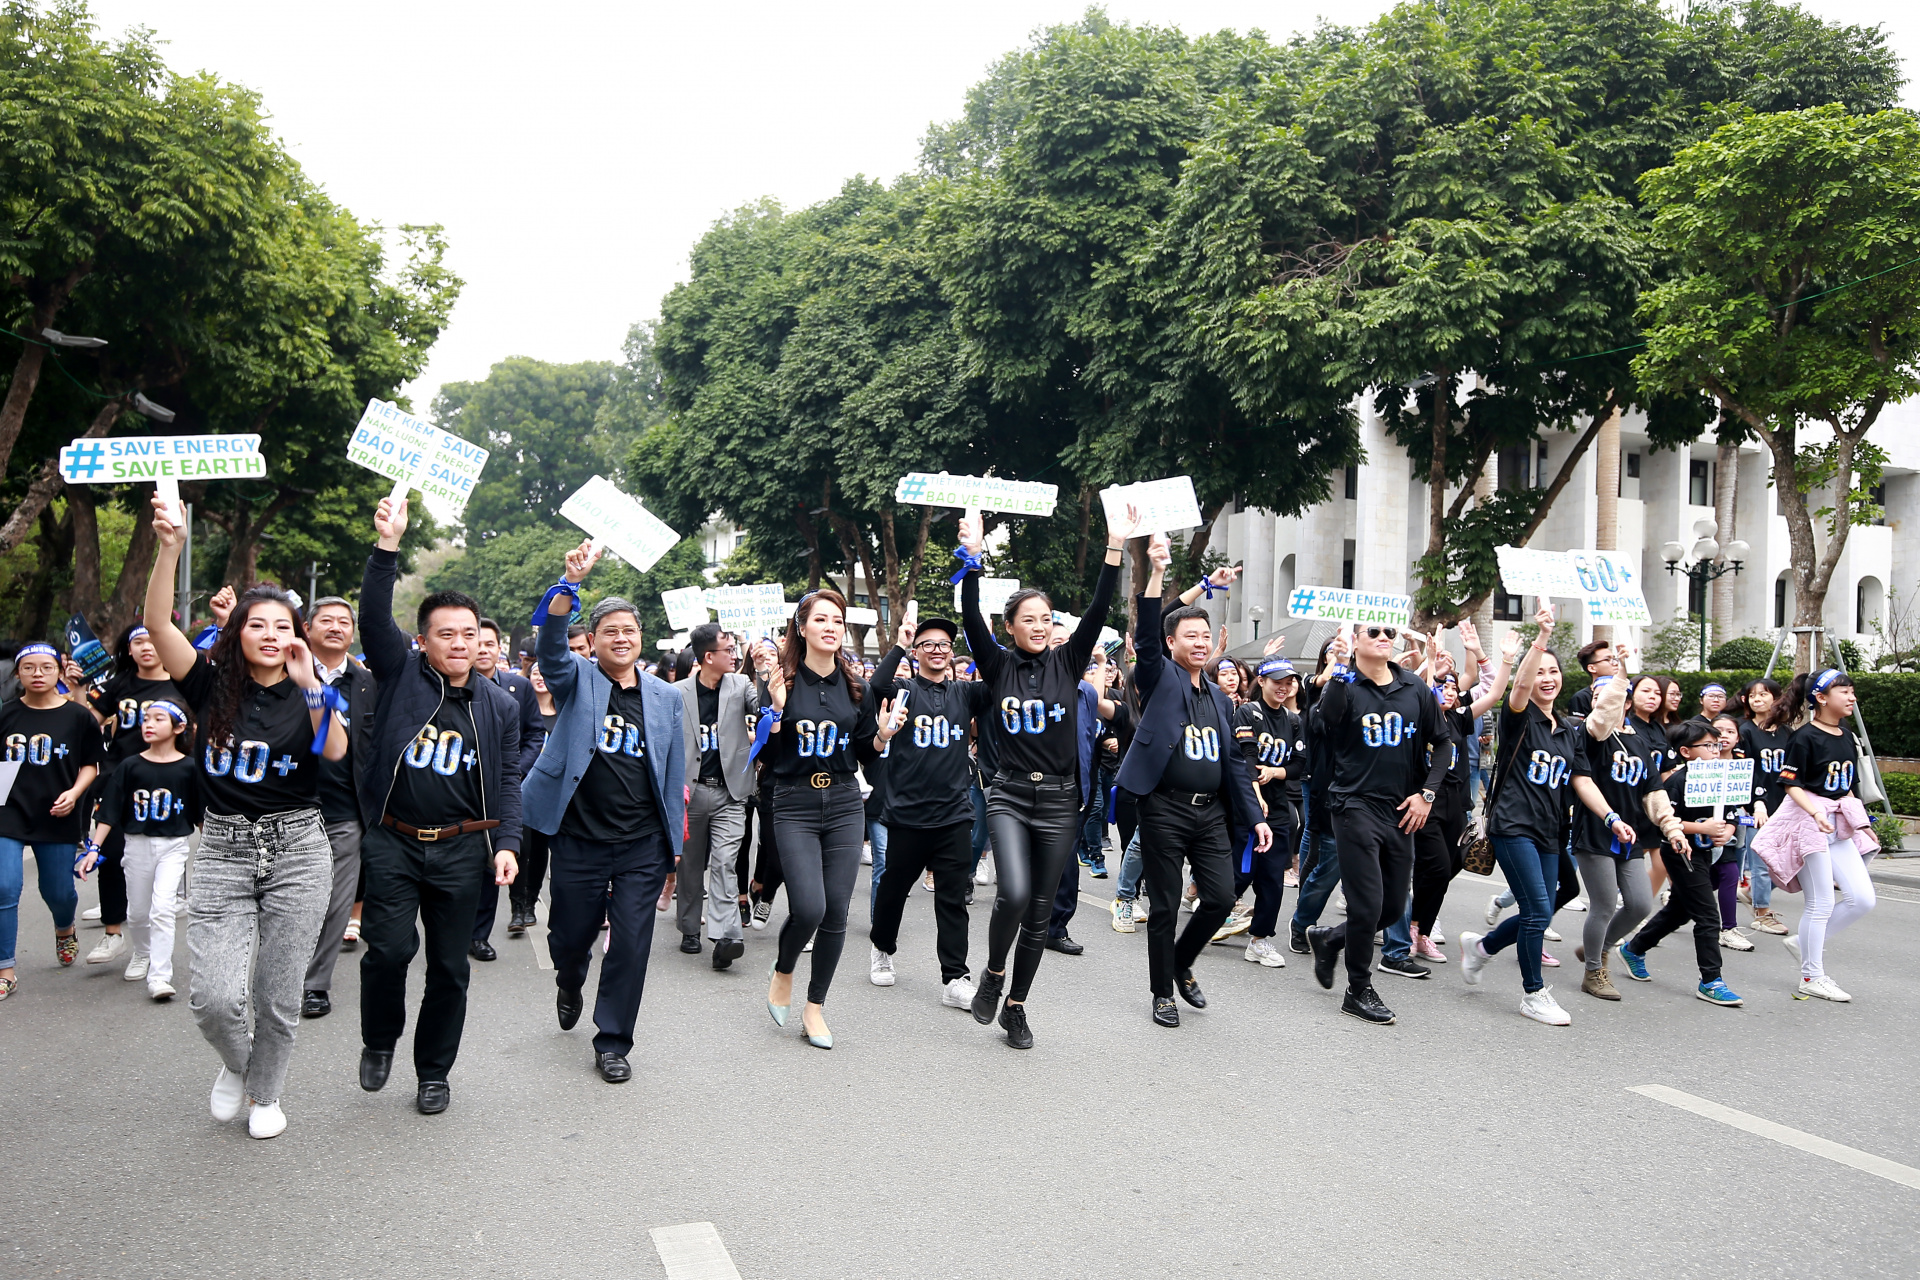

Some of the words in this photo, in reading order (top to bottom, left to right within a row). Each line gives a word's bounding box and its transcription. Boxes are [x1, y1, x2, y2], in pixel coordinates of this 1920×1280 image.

[110, 440, 166, 456] SAVE
[174, 438, 256, 455] ENERGY
[441, 436, 485, 465] SAVE
[112, 460, 174, 478] SAVE
[180, 457, 261, 476] EARTH
[435, 451, 478, 475] ENERGY
[428, 463, 473, 492] SAVE
[421, 480, 465, 506] EARTH
[1574, 555, 1632, 592] 60+
[758, 586, 782, 596] SAVE
[1319, 590, 1352, 604] SAVE
[1356, 594, 1408, 609] ENERGY
[761, 605, 784, 616] SAVE
[762, 618, 786, 626] EARTH
[1317, 605, 1354, 620] SAVE
[1357, 608, 1407, 625] EARTH
[1001, 696, 1066, 735] 60+
[795, 719, 850, 758] 60+
[913, 714, 964, 749] 60+
[1361, 711, 1417, 748] 60+
[6, 733, 70, 766] 60+
[404, 724, 478, 776] 60+
[1727, 772, 1751, 780] ENERGY
[1728, 761, 1753, 771] SAVE
[1824, 760, 1854, 792] 60
[1725, 794, 1750, 803] EARTH
[1726, 782, 1750, 792] SAVE
[133, 787, 185, 822] 60+
